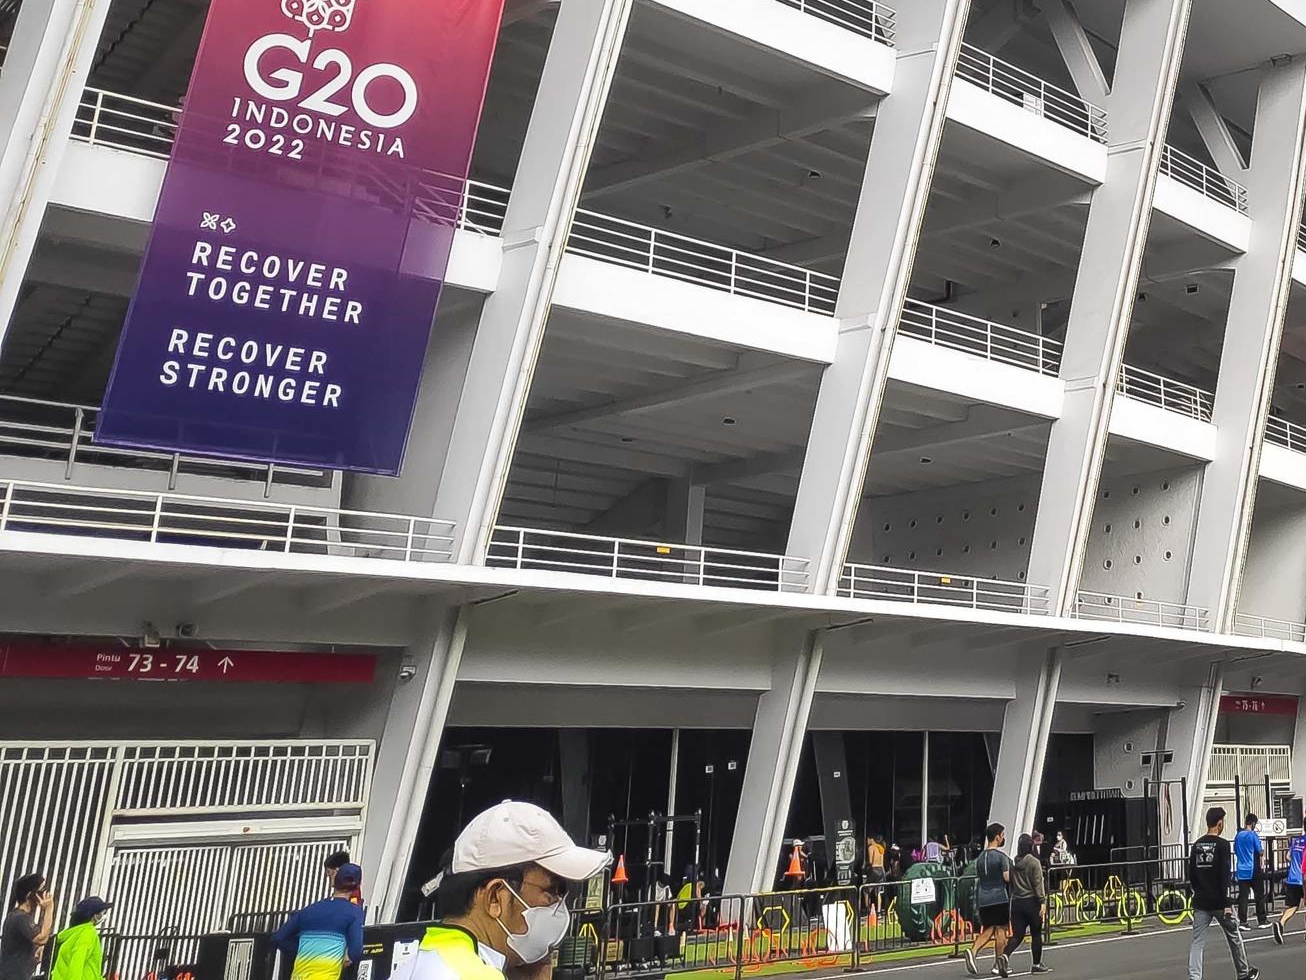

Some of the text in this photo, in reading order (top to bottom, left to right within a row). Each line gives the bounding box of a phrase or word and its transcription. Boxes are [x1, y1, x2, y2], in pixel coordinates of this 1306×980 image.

[243, 33, 418, 128] G20
[222, 124, 304, 159] 2022
[231, 97, 405, 158] INDONESIA
[191, 241, 348, 291] RECOVER
[186, 271, 363, 324] TOGETHER
[168, 328, 327, 374] RECOVER
[159, 360, 342, 407] STRONGER
[96, 653, 121, 662] Pintu
[128, 653, 154, 672] 73
[174, 655, 199, 673] 74
